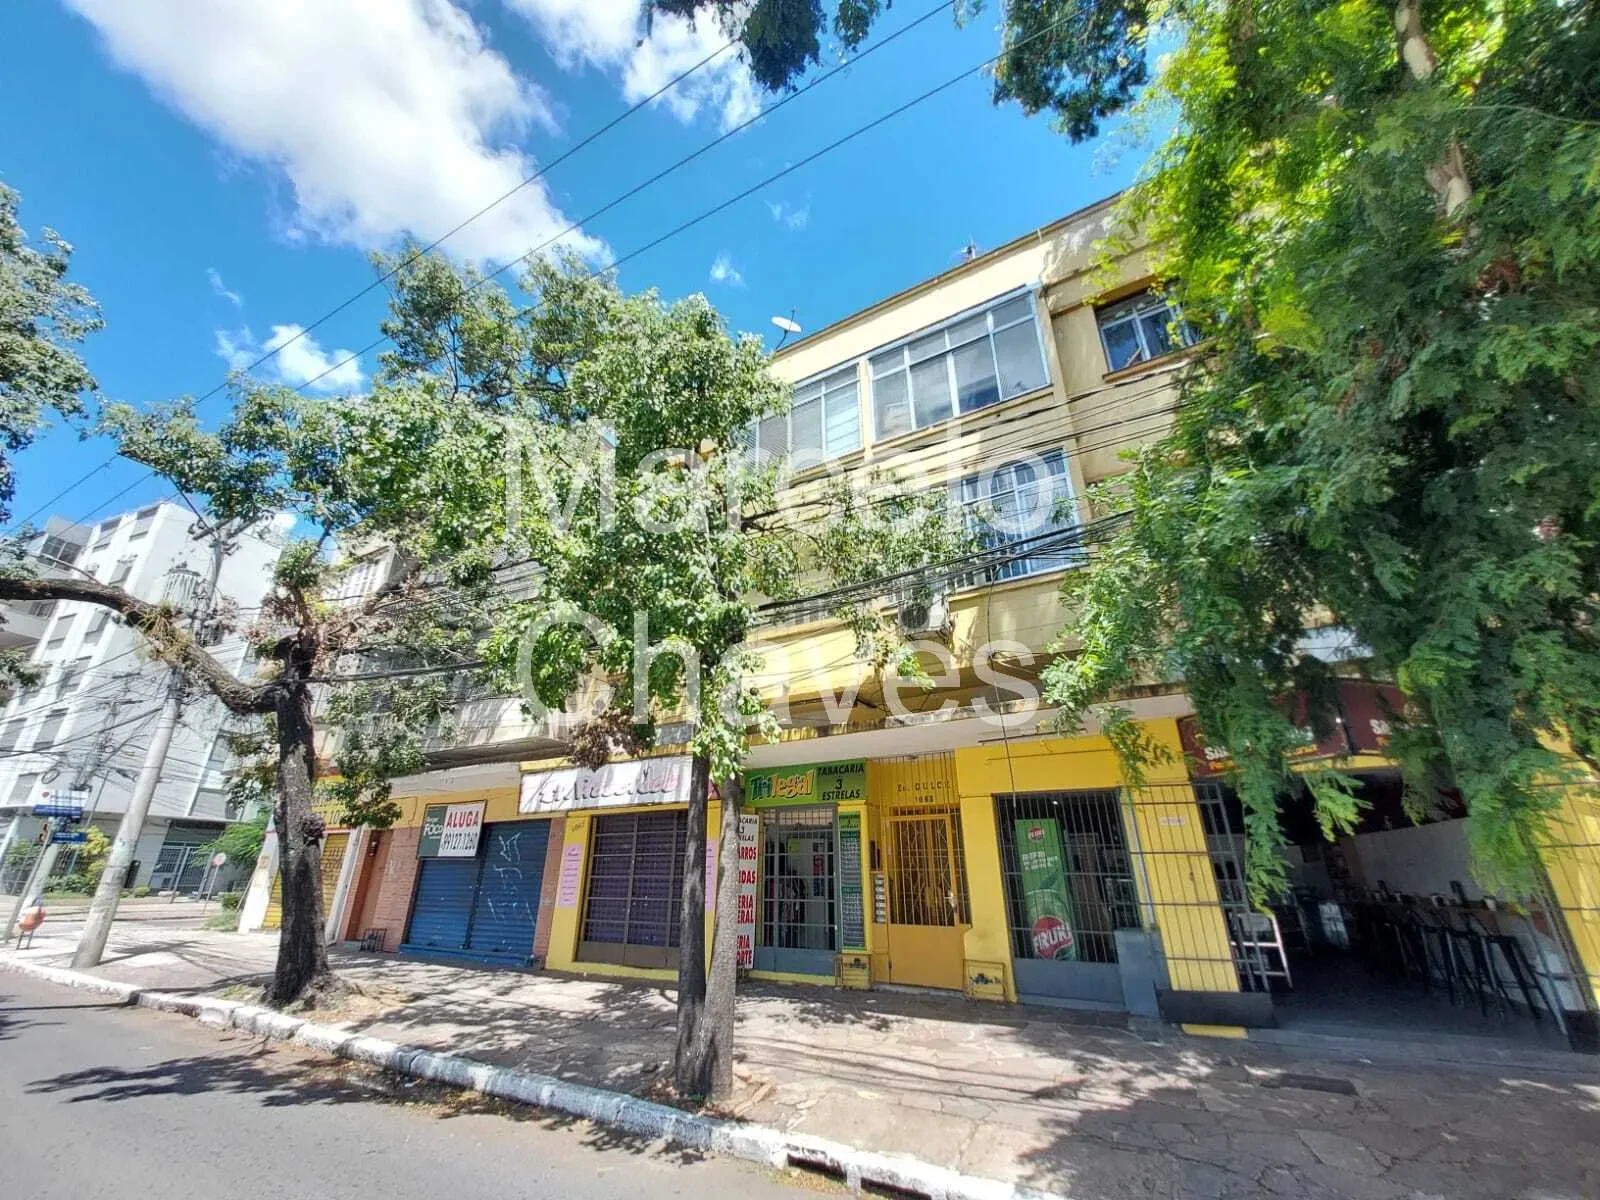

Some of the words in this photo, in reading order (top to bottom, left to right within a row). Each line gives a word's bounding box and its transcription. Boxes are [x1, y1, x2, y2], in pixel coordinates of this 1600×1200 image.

[818, 764, 865, 777] TABACARIA
[835, 778, 843, 790] 3
[822, 789, 861, 801] ESTRELAS
[446, 811, 480, 829] ALUGA
